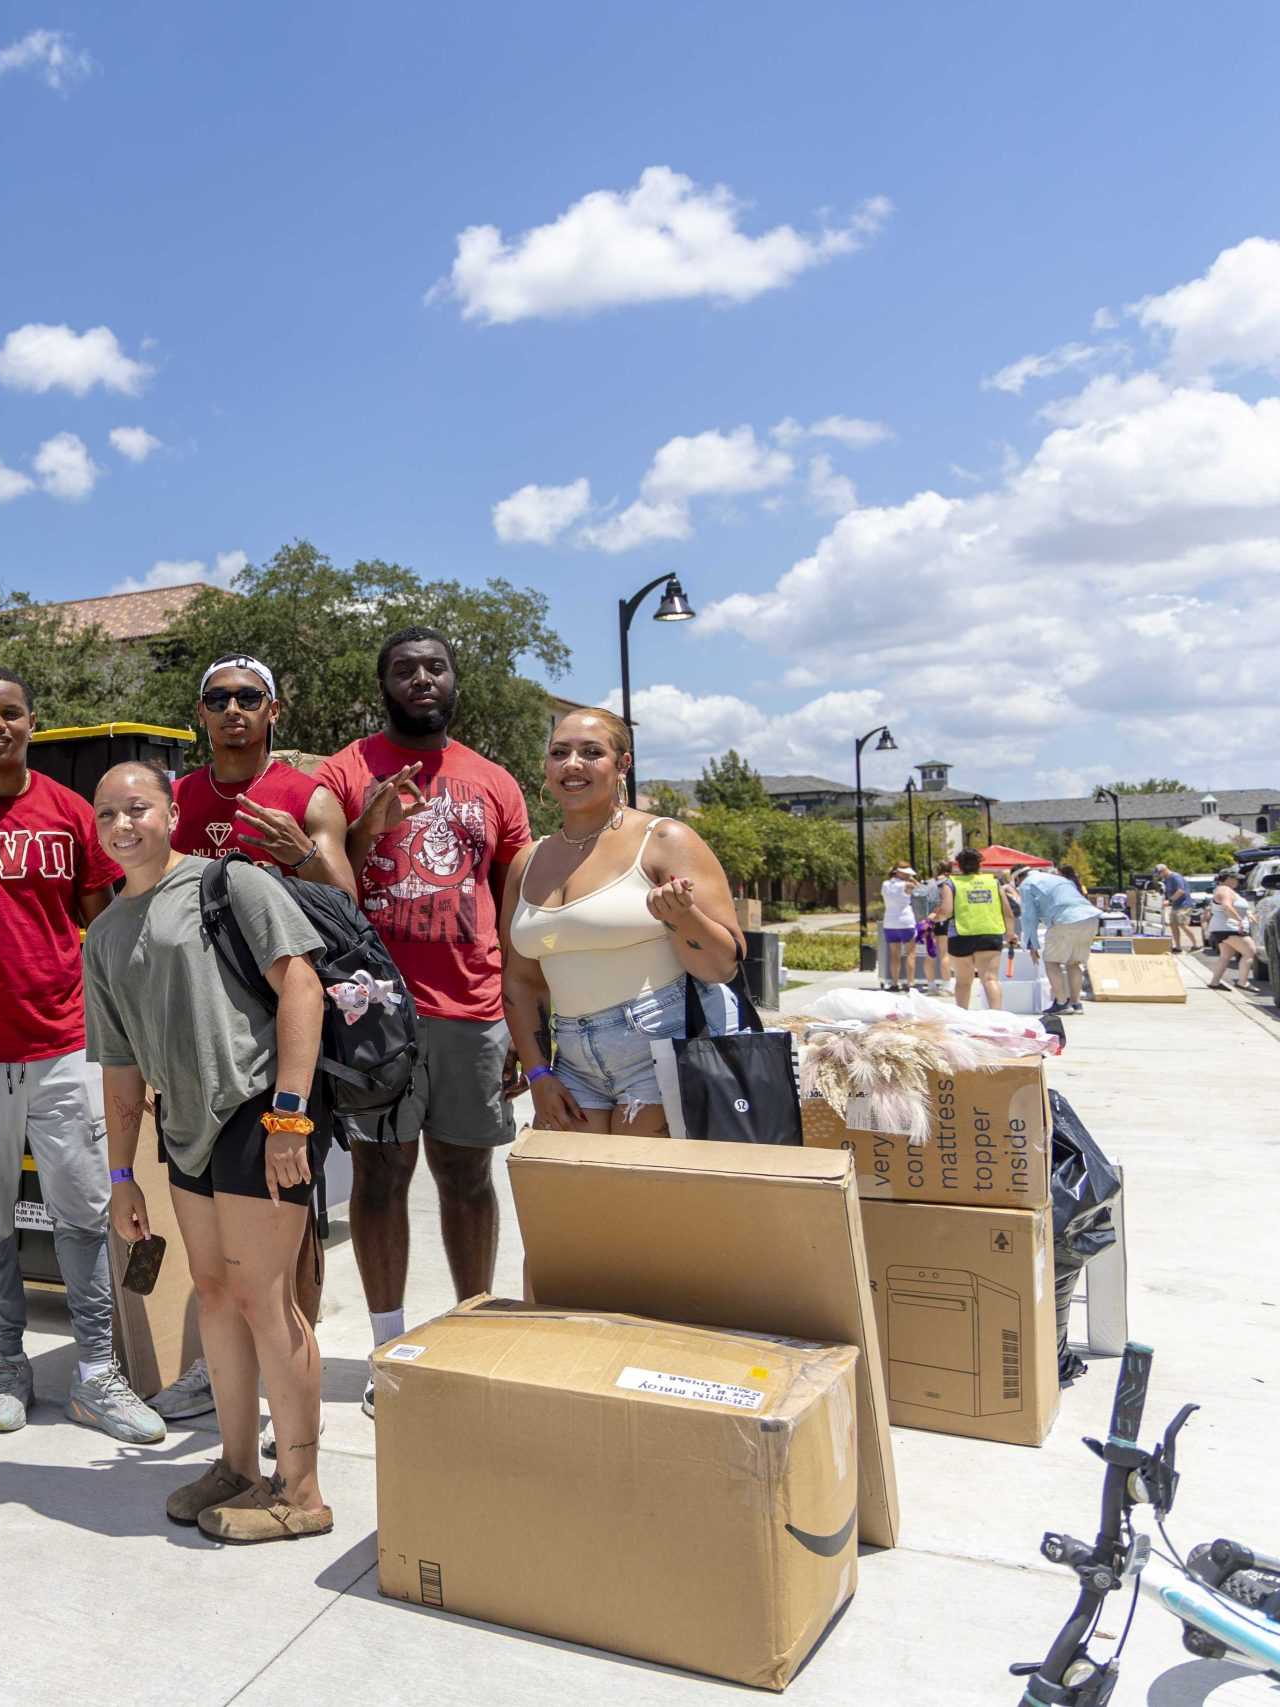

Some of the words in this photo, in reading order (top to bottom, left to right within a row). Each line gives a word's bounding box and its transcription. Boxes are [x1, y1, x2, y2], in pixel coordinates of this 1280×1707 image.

[192, 848, 211, 857] NU
[873, 1135, 895, 1187] very
[936, 1079, 959, 1190] mattress
[973, 1106, 998, 1192] topper
[1003, 1118, 1029, 1193] inside
